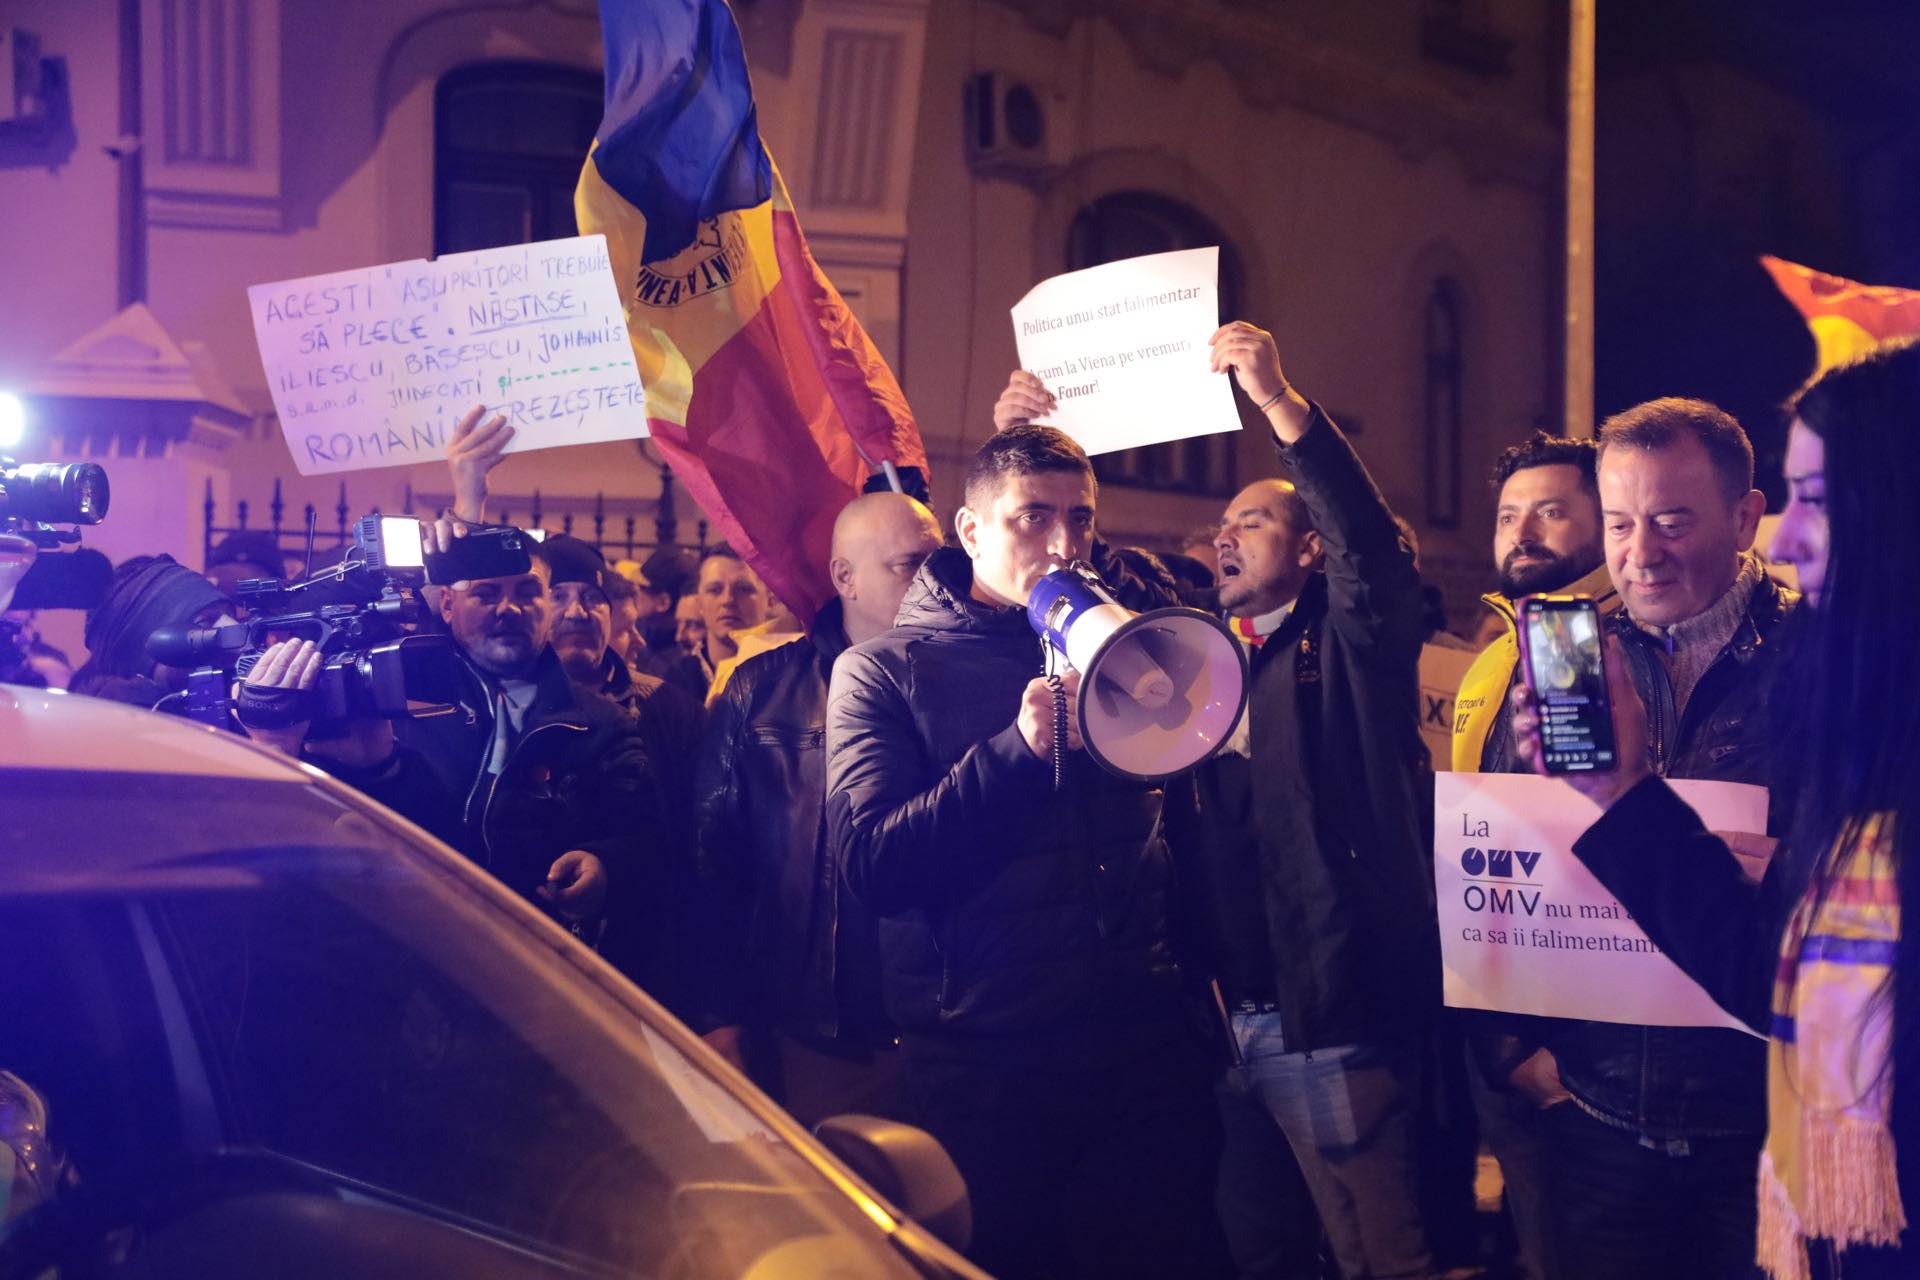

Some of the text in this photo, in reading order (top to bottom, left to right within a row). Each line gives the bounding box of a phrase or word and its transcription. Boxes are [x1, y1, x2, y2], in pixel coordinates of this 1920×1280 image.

[1023, 286, 1201, 336] Politica unui stat falimentar
[1065, 358, 1077, 375] la
[1078, 355, 1116, 372] Viena
[1118, 350, 1135, 368] pe
[1058, 380, 1101, 400] Fanar!
[1462, 813, 1490, 838] La
[1463, 885, 1541, 917] OMV
[1545, 903, 1572, 919] nu
[1580, 902, 1620, 920] mai
[1462, 927, 1482, 942] ca
[1488, 929, 1507, 944] sa
[1513, 928, 1526, 946] ii
